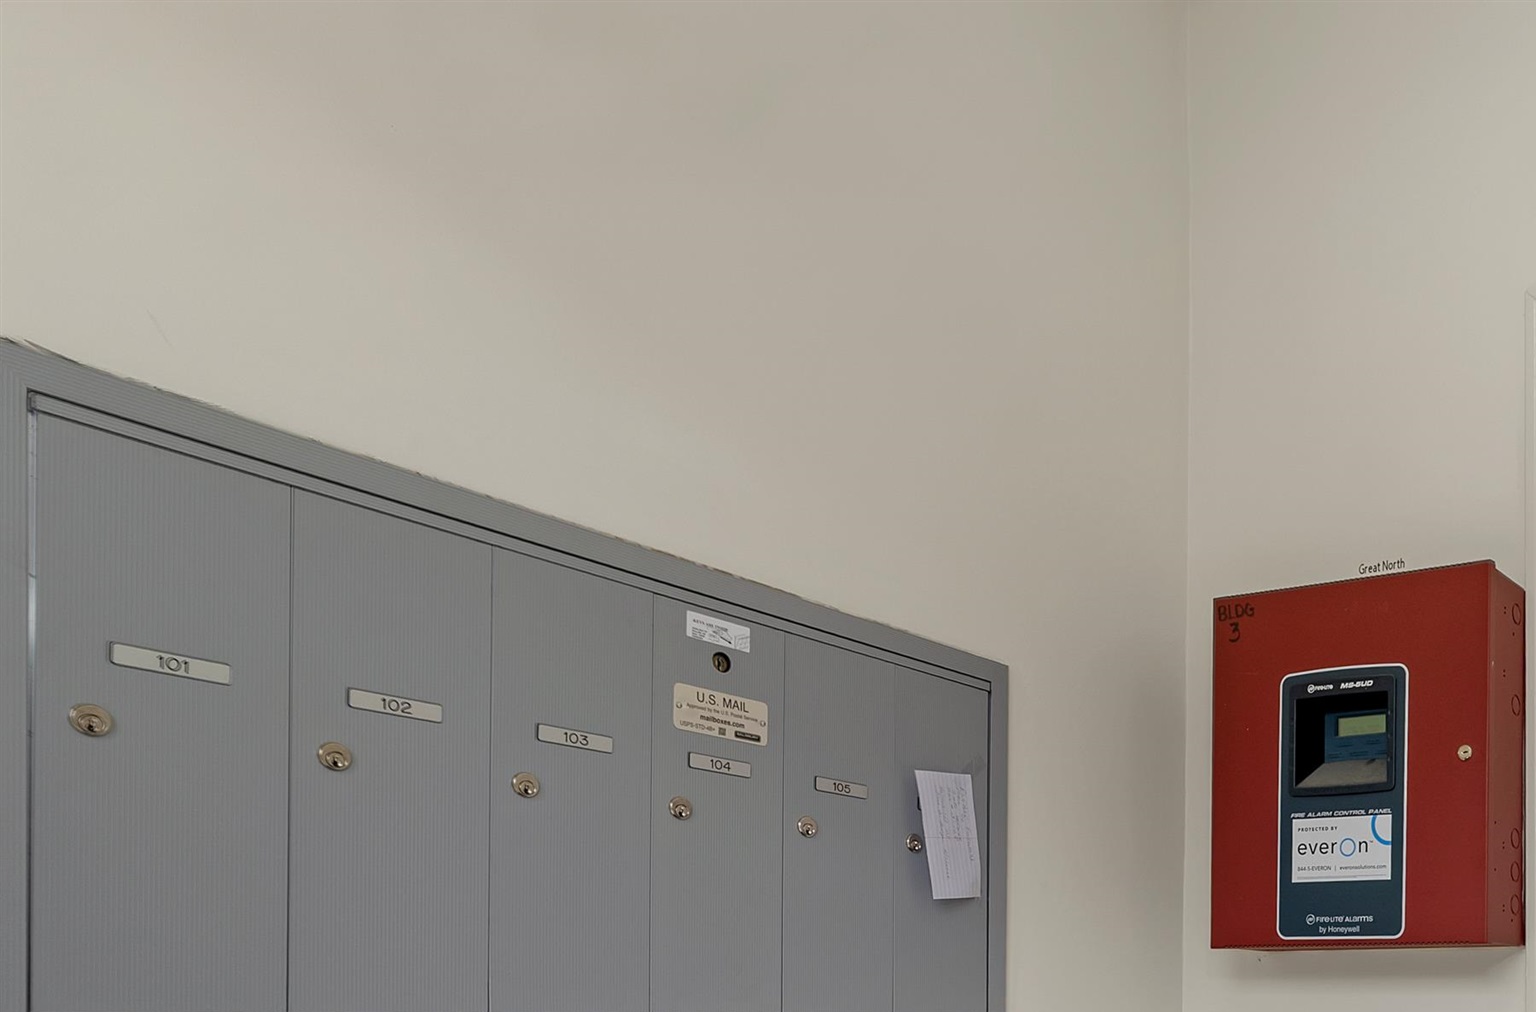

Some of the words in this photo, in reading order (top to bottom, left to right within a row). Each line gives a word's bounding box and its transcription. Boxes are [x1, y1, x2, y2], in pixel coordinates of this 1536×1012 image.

[1359, 563, 1380, 574] Great
[1382, 558, 1405, 571] North
[1218, 602, 1254, 622] BLDG
[1228, 622, 1241, 642] 3
[156, 654, 190, 675] 101
[381, 697, 413, 715] 102
[686, 702, 706, 712] Approved
[696, 691, 719, 706] U.S.
[722, 697, 749, 713] MAIL
[700, 714, 745, 729] mailboxes.com
[563, 731, 589, 746] 103
[710, 759, 731, 771] 104
[833, 782, 851, 794] 105
[1319, 926, 1326, 934] by
[1328, 925, 1360, 934] Honeywell
